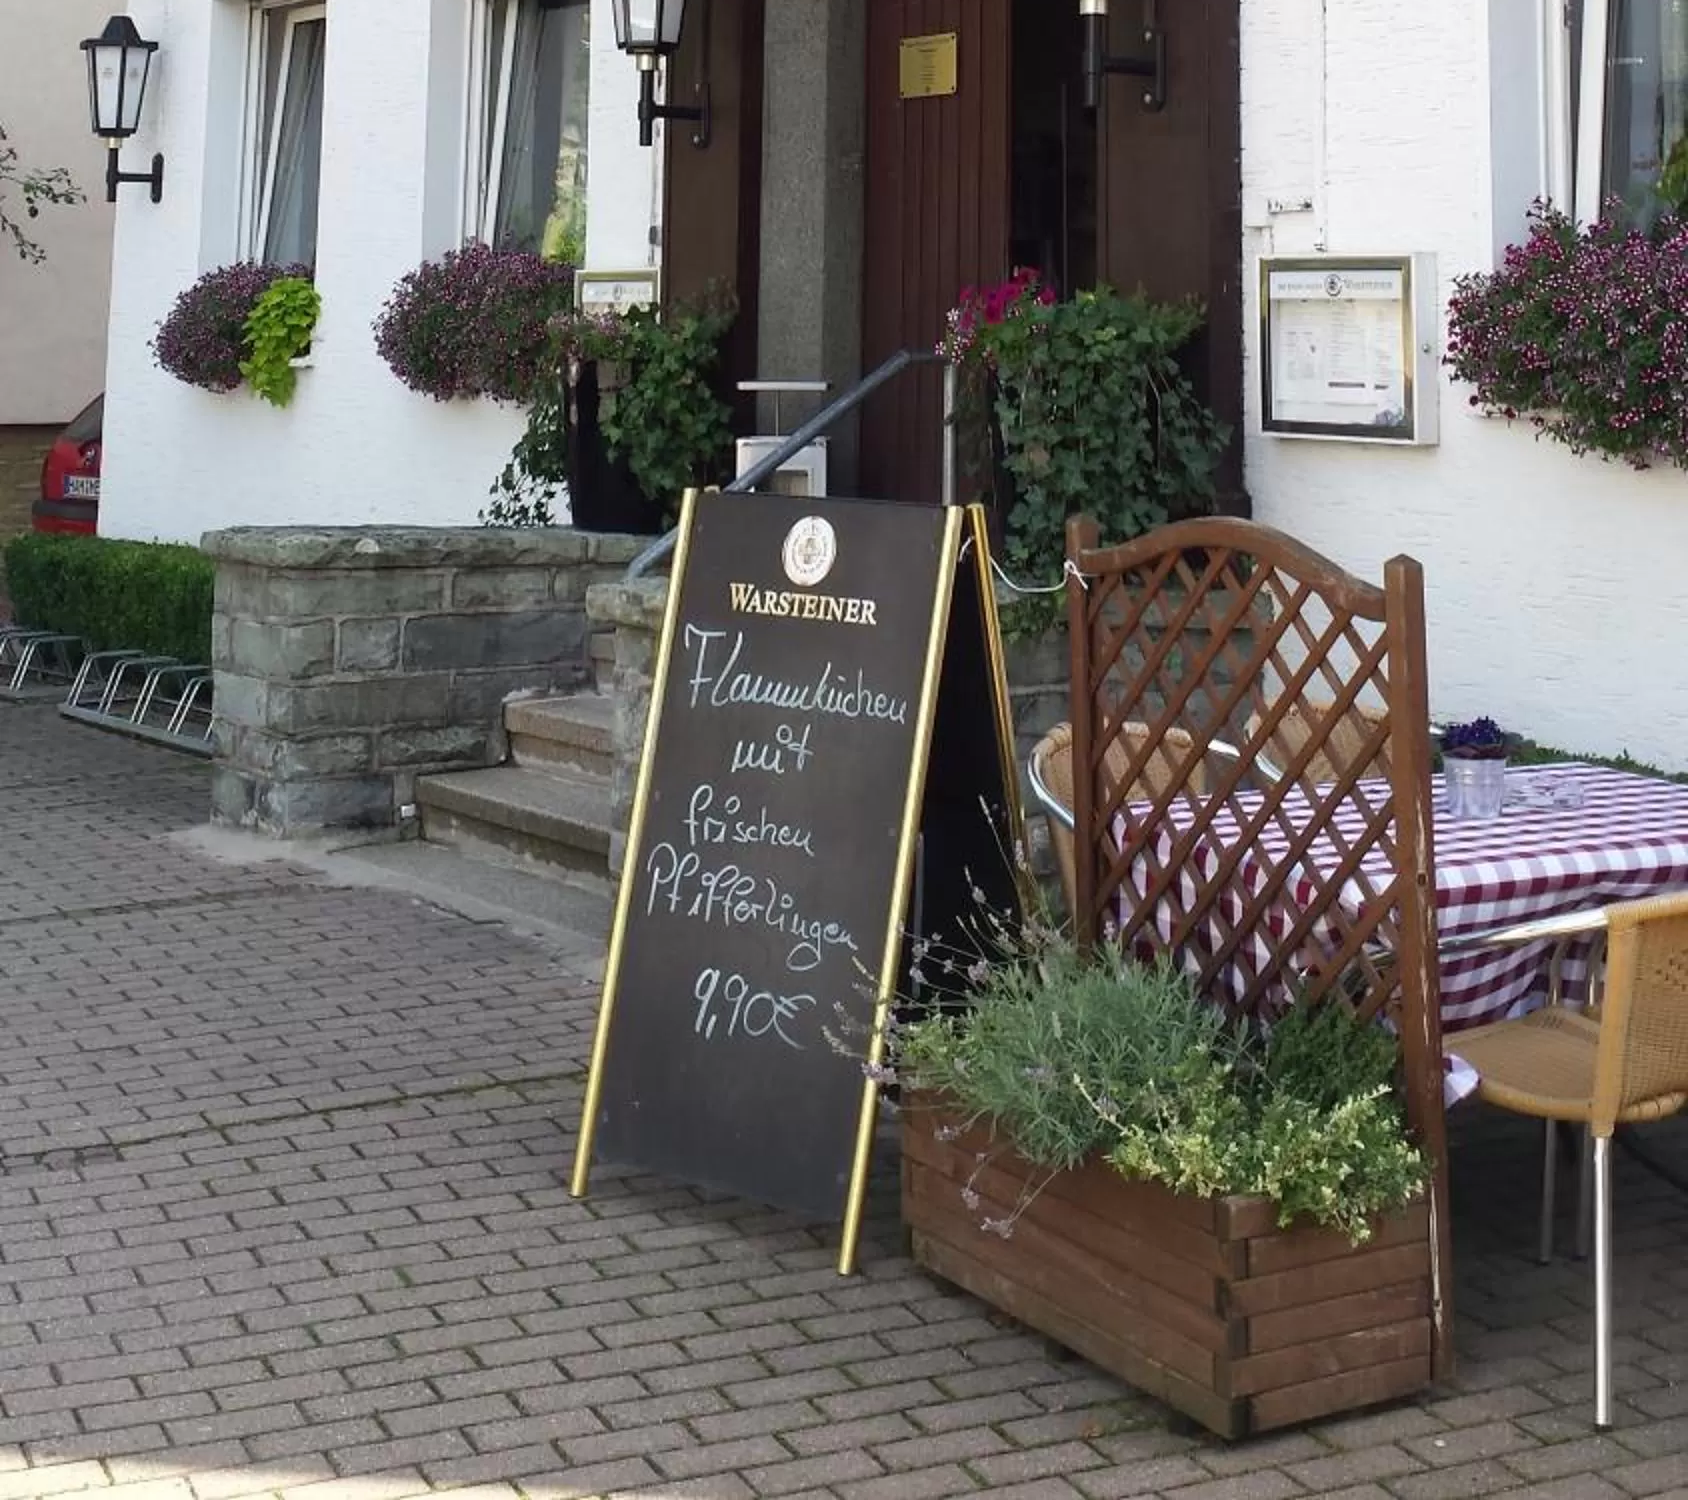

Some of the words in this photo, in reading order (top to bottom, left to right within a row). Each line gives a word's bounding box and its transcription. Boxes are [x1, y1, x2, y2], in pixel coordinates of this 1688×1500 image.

[729, 582, 877, 625] WARSTEINER
[731, 723, 814, 774] mit
[683, 784, 815, 857] frischen
[647, 842, 859, 971] Pfifferlingen
[695, 967, 817, 1049] 9,90€
